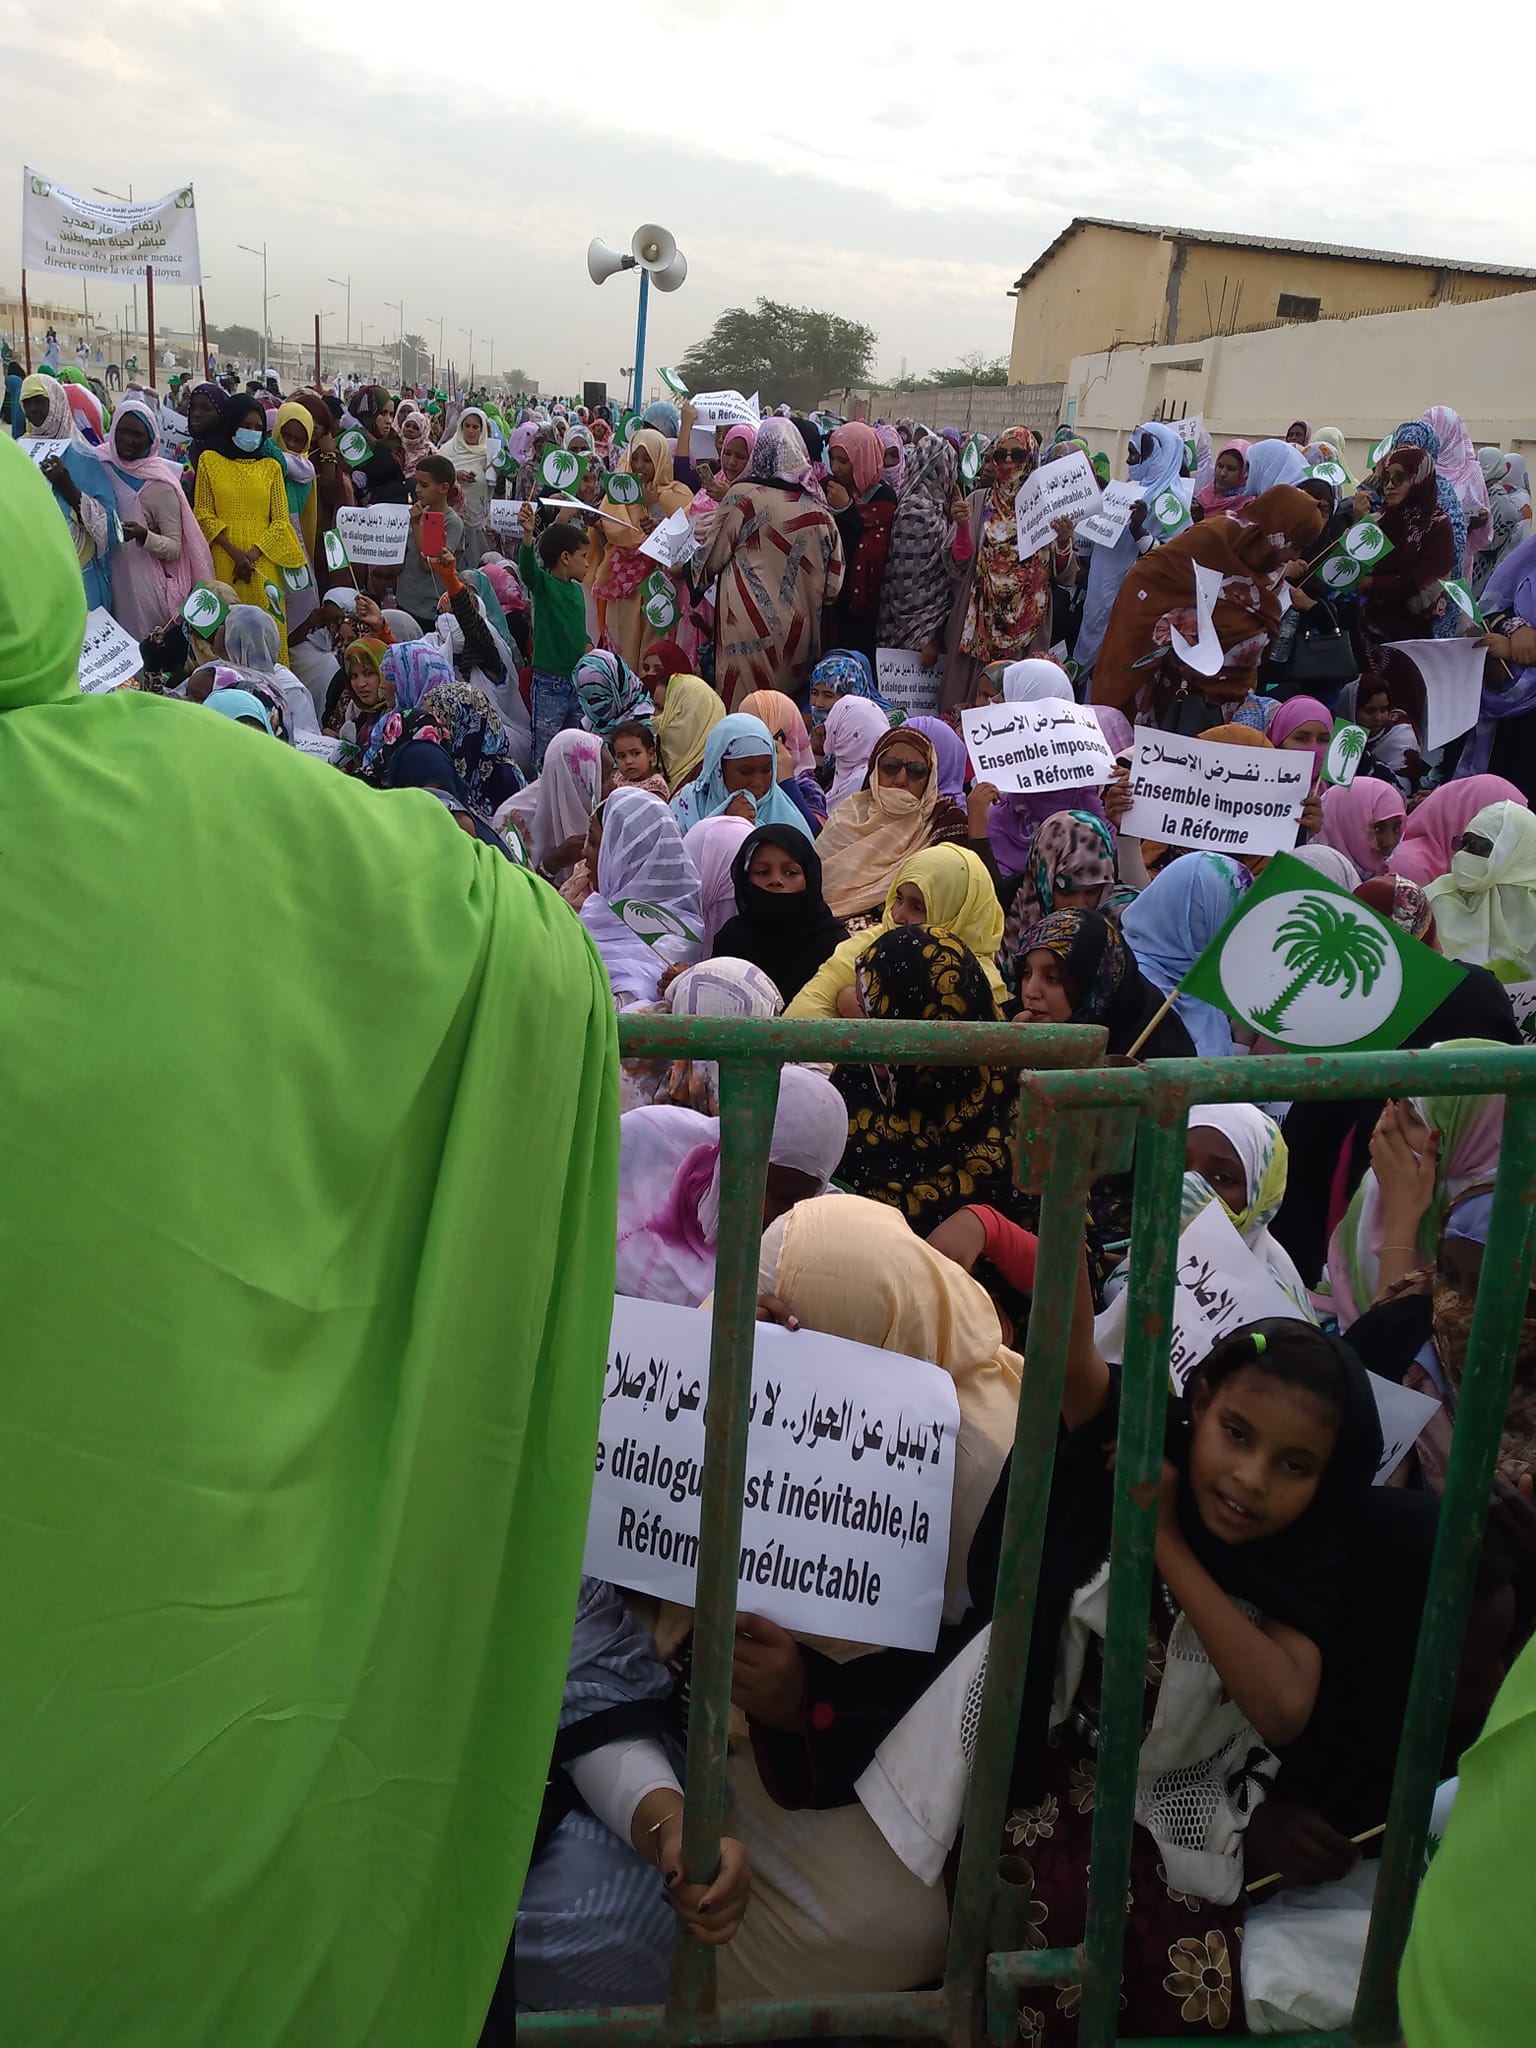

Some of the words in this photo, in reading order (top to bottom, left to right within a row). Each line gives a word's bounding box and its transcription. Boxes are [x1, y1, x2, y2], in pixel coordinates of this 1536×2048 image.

[60, 230, 105, 246] المواطنين
[62, 215, 95, 231] تهديد
[131, 220, 162, 234] ارتفاع
[45, 241, 56, 252] La
[60, 243, 92, 258] hausse
[93, 250, 107, 260] des
[110, 250, 129, 263] prix
[131, 253, 149, 262] une
[152, 254, 182, 263] menace
[108, 237, 135, 248] لحياة
[137, 237, 166, 249] مباشر
[44, 255, 77, 270] directe
[80, 261, 109, 274] contre
[110, 265, 119, 274] la
[122, 265, 135, 275] vie
[153, 267, 181, 279] itoyen
[709, 409, 716, 420] la
[352, 544, 377, 557] Réforme
[971, 714, 1030, 745] الإصلاح
[978, 743, 1049, 770] Ensemble
[1052, 739, 1109, 757] imposons
[1140, 744, 1201, 772] الإصلاح
[1017, 774, 1032, 789] la
[1034, 764, 1095, 786] Réforme
[1134, 777, 1211, 808] Ensemble
[1215, 793, 1292, 818] imposons
[1162, 814, 1177, 834] la
[1181, 817, 1249, 844] Réforme
[602, 1351, 670, 1414] الإصلا
[665, 1369, 700, 1423] عن
[761, 1379, 782, 1427] لا
[851, 1408, 883, 1461] عن
[886, 1411, 928, 1475] بديل
[931, 1420, 944, 1464] لا
[595, 1441, 606, 1472] e
[611, 1437, 704, 1502] dialogu
[744, 1469, 774, 1513] st
[618, 1506, 699, 1569] Réform
[738, 1538, 881, 1606] néluctable
